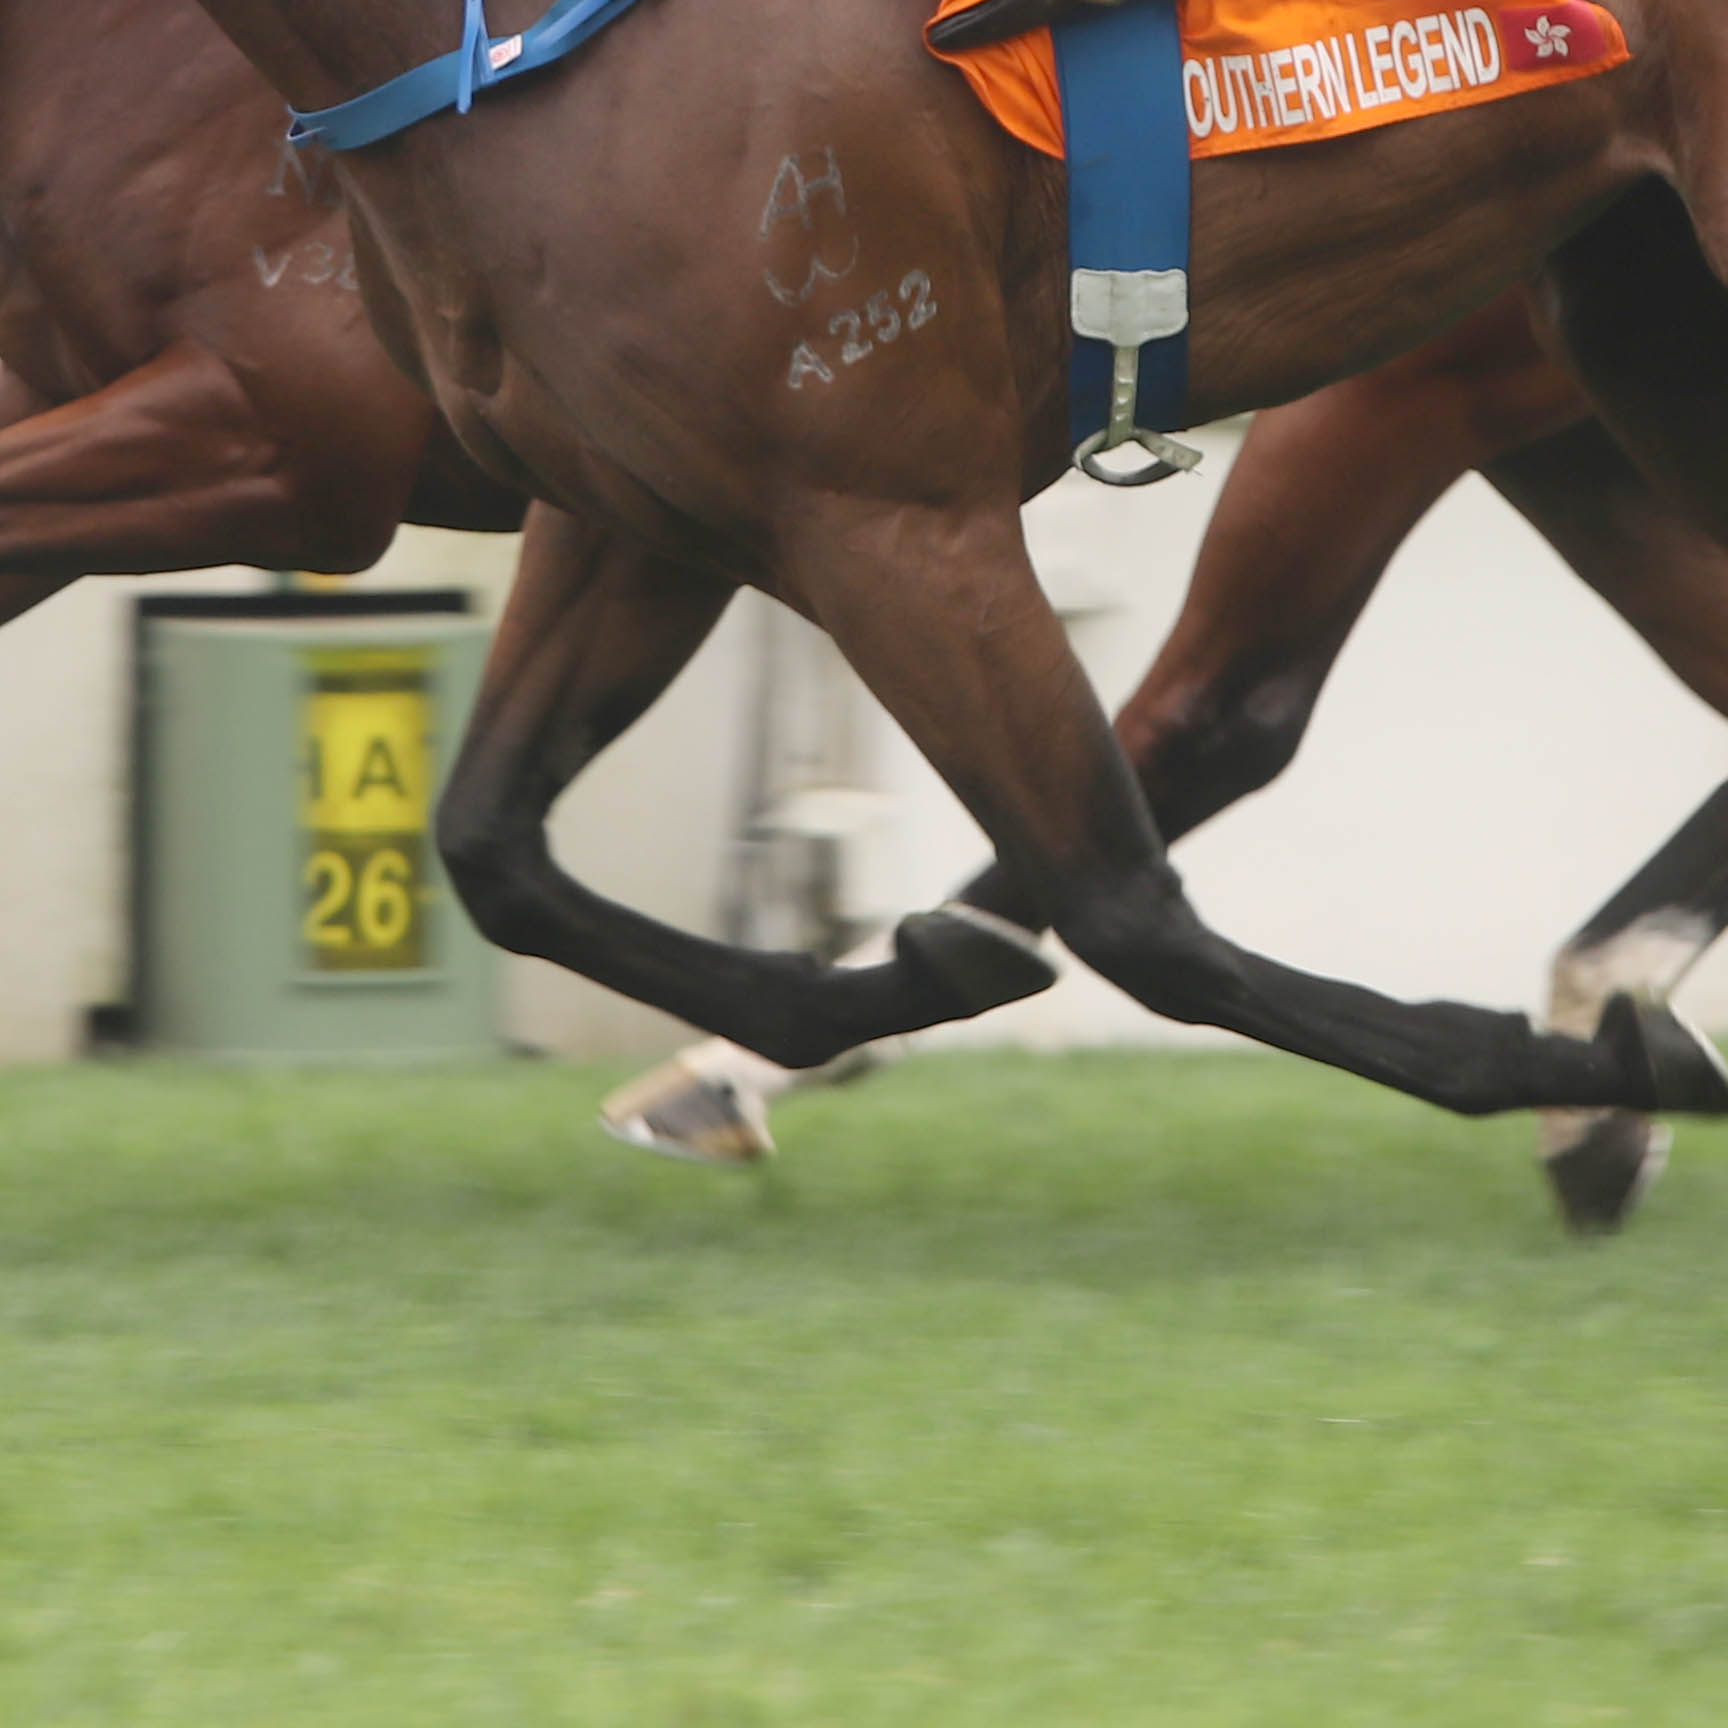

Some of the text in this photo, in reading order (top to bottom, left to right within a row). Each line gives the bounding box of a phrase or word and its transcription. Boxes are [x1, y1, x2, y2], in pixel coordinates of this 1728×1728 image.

[1183, 7, 1500, 138] OUTHERN LEGEND
[304, 848, 414, 947] 26
